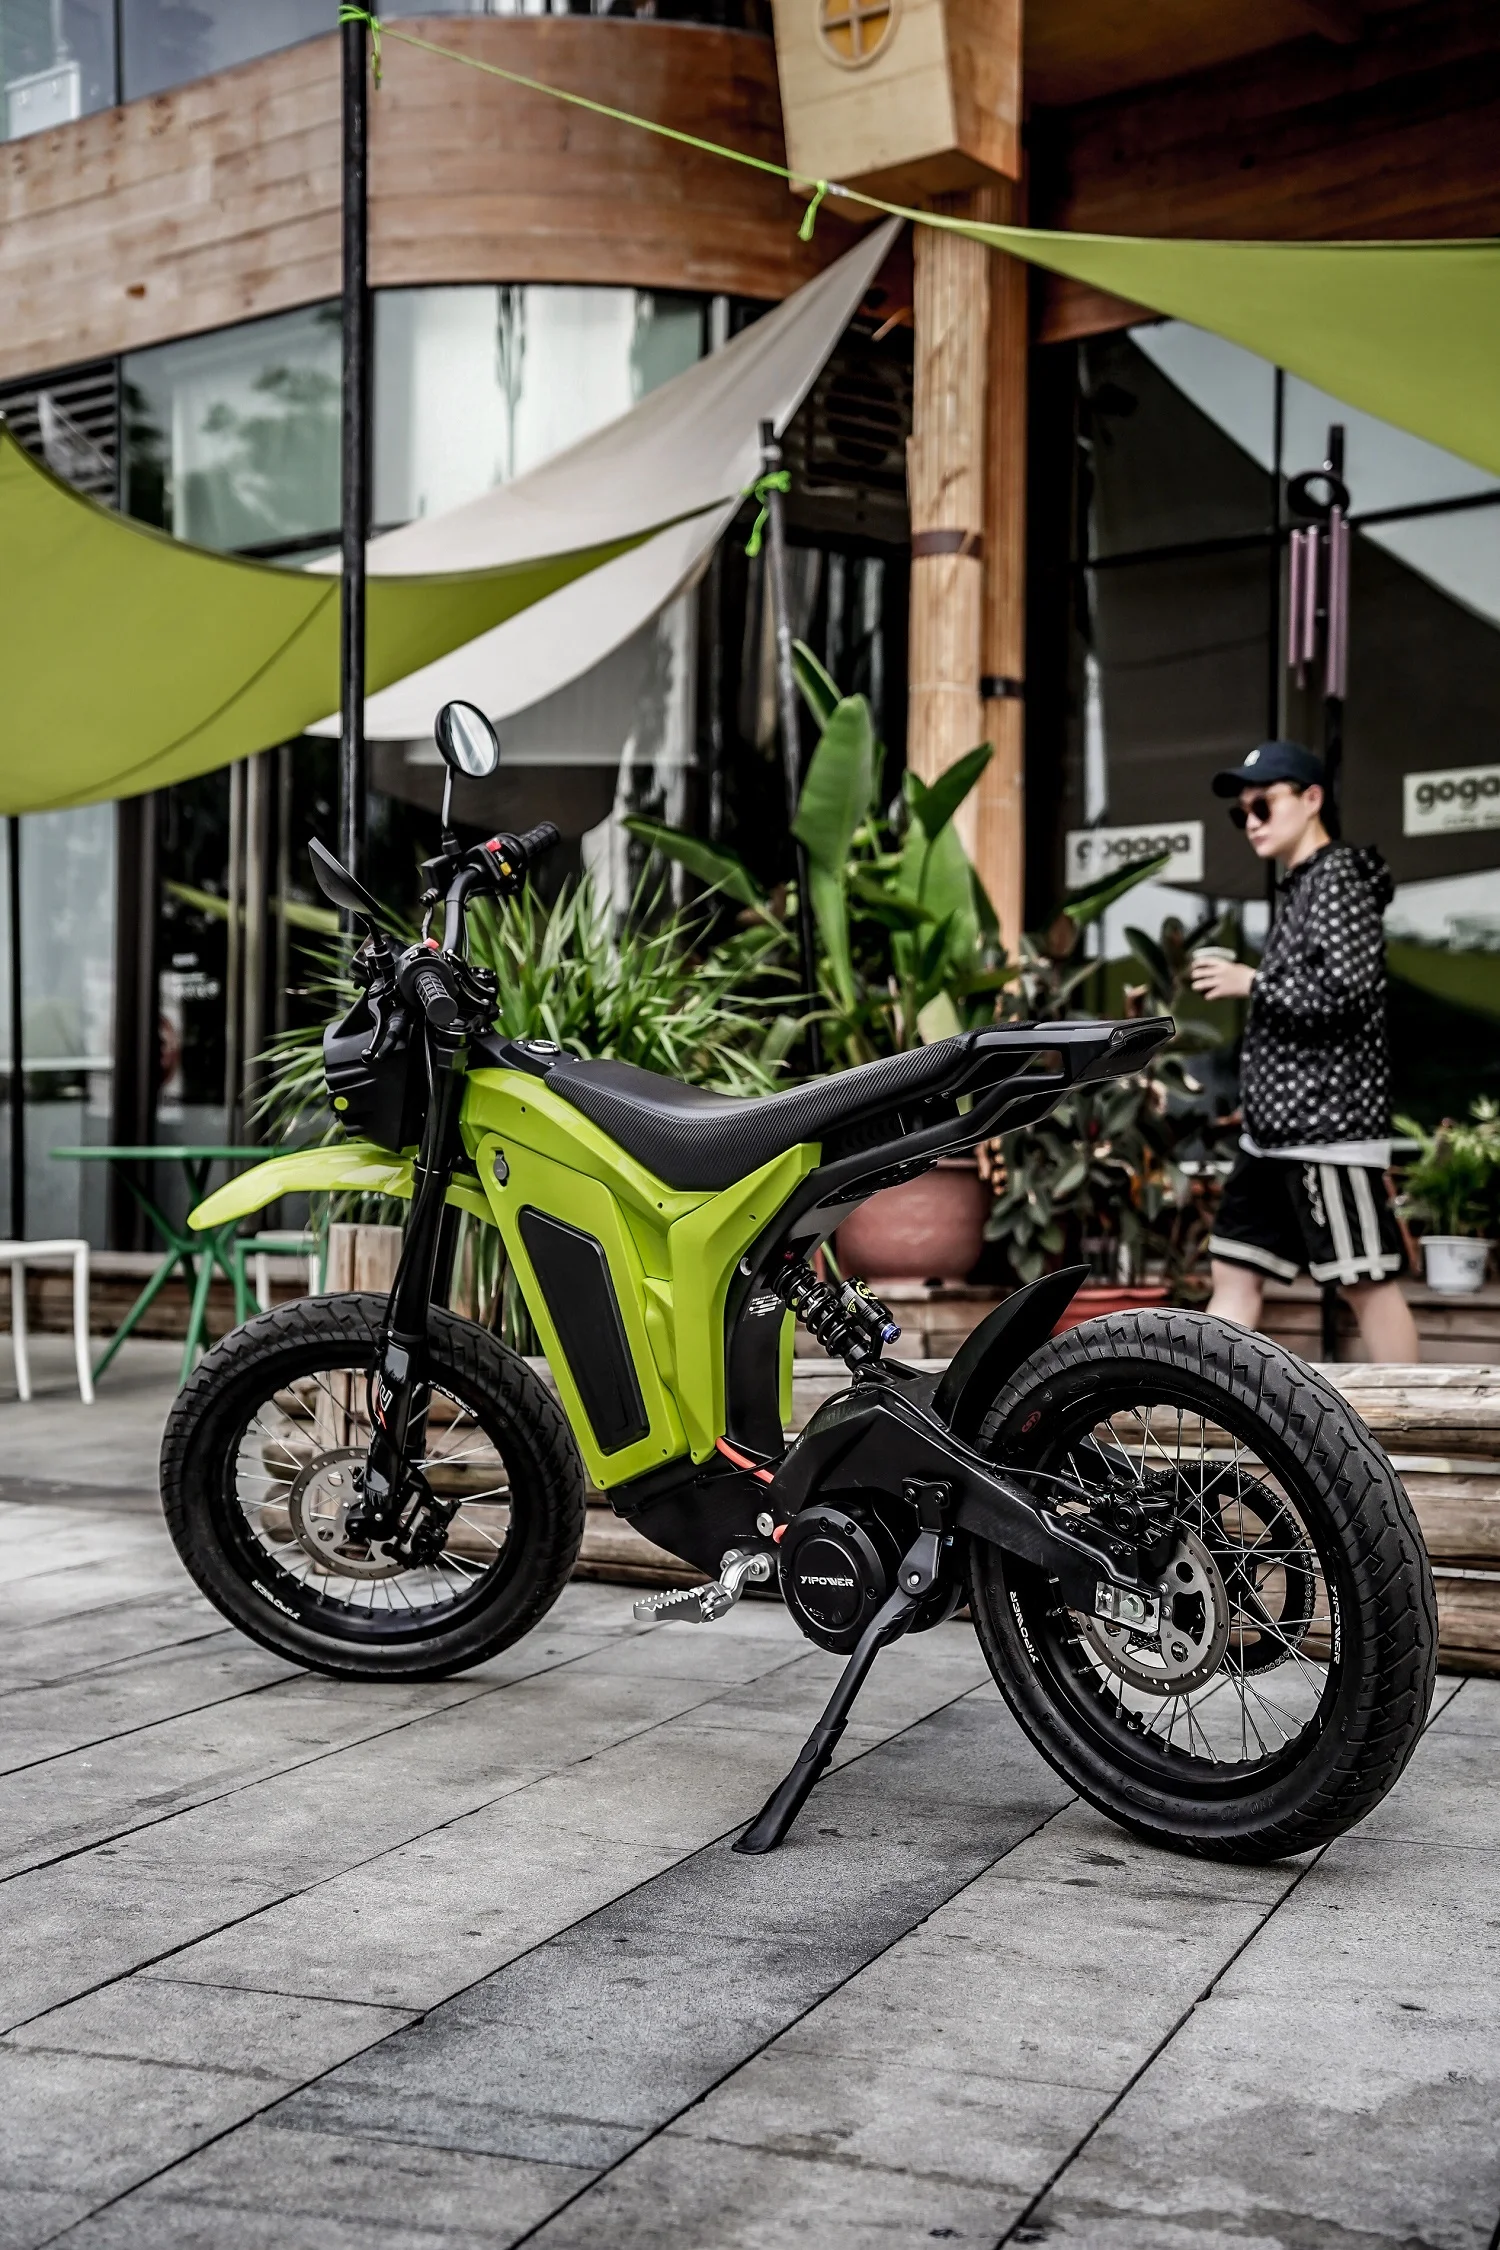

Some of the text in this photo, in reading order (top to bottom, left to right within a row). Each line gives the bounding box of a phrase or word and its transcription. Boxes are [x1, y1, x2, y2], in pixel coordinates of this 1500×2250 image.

[800, 1575, 854, 1587] YIPOWER
[1010, 1591, 1039, 1664] YIPOWER
[1330, 1584, 1341, 1664] YIPOWER
